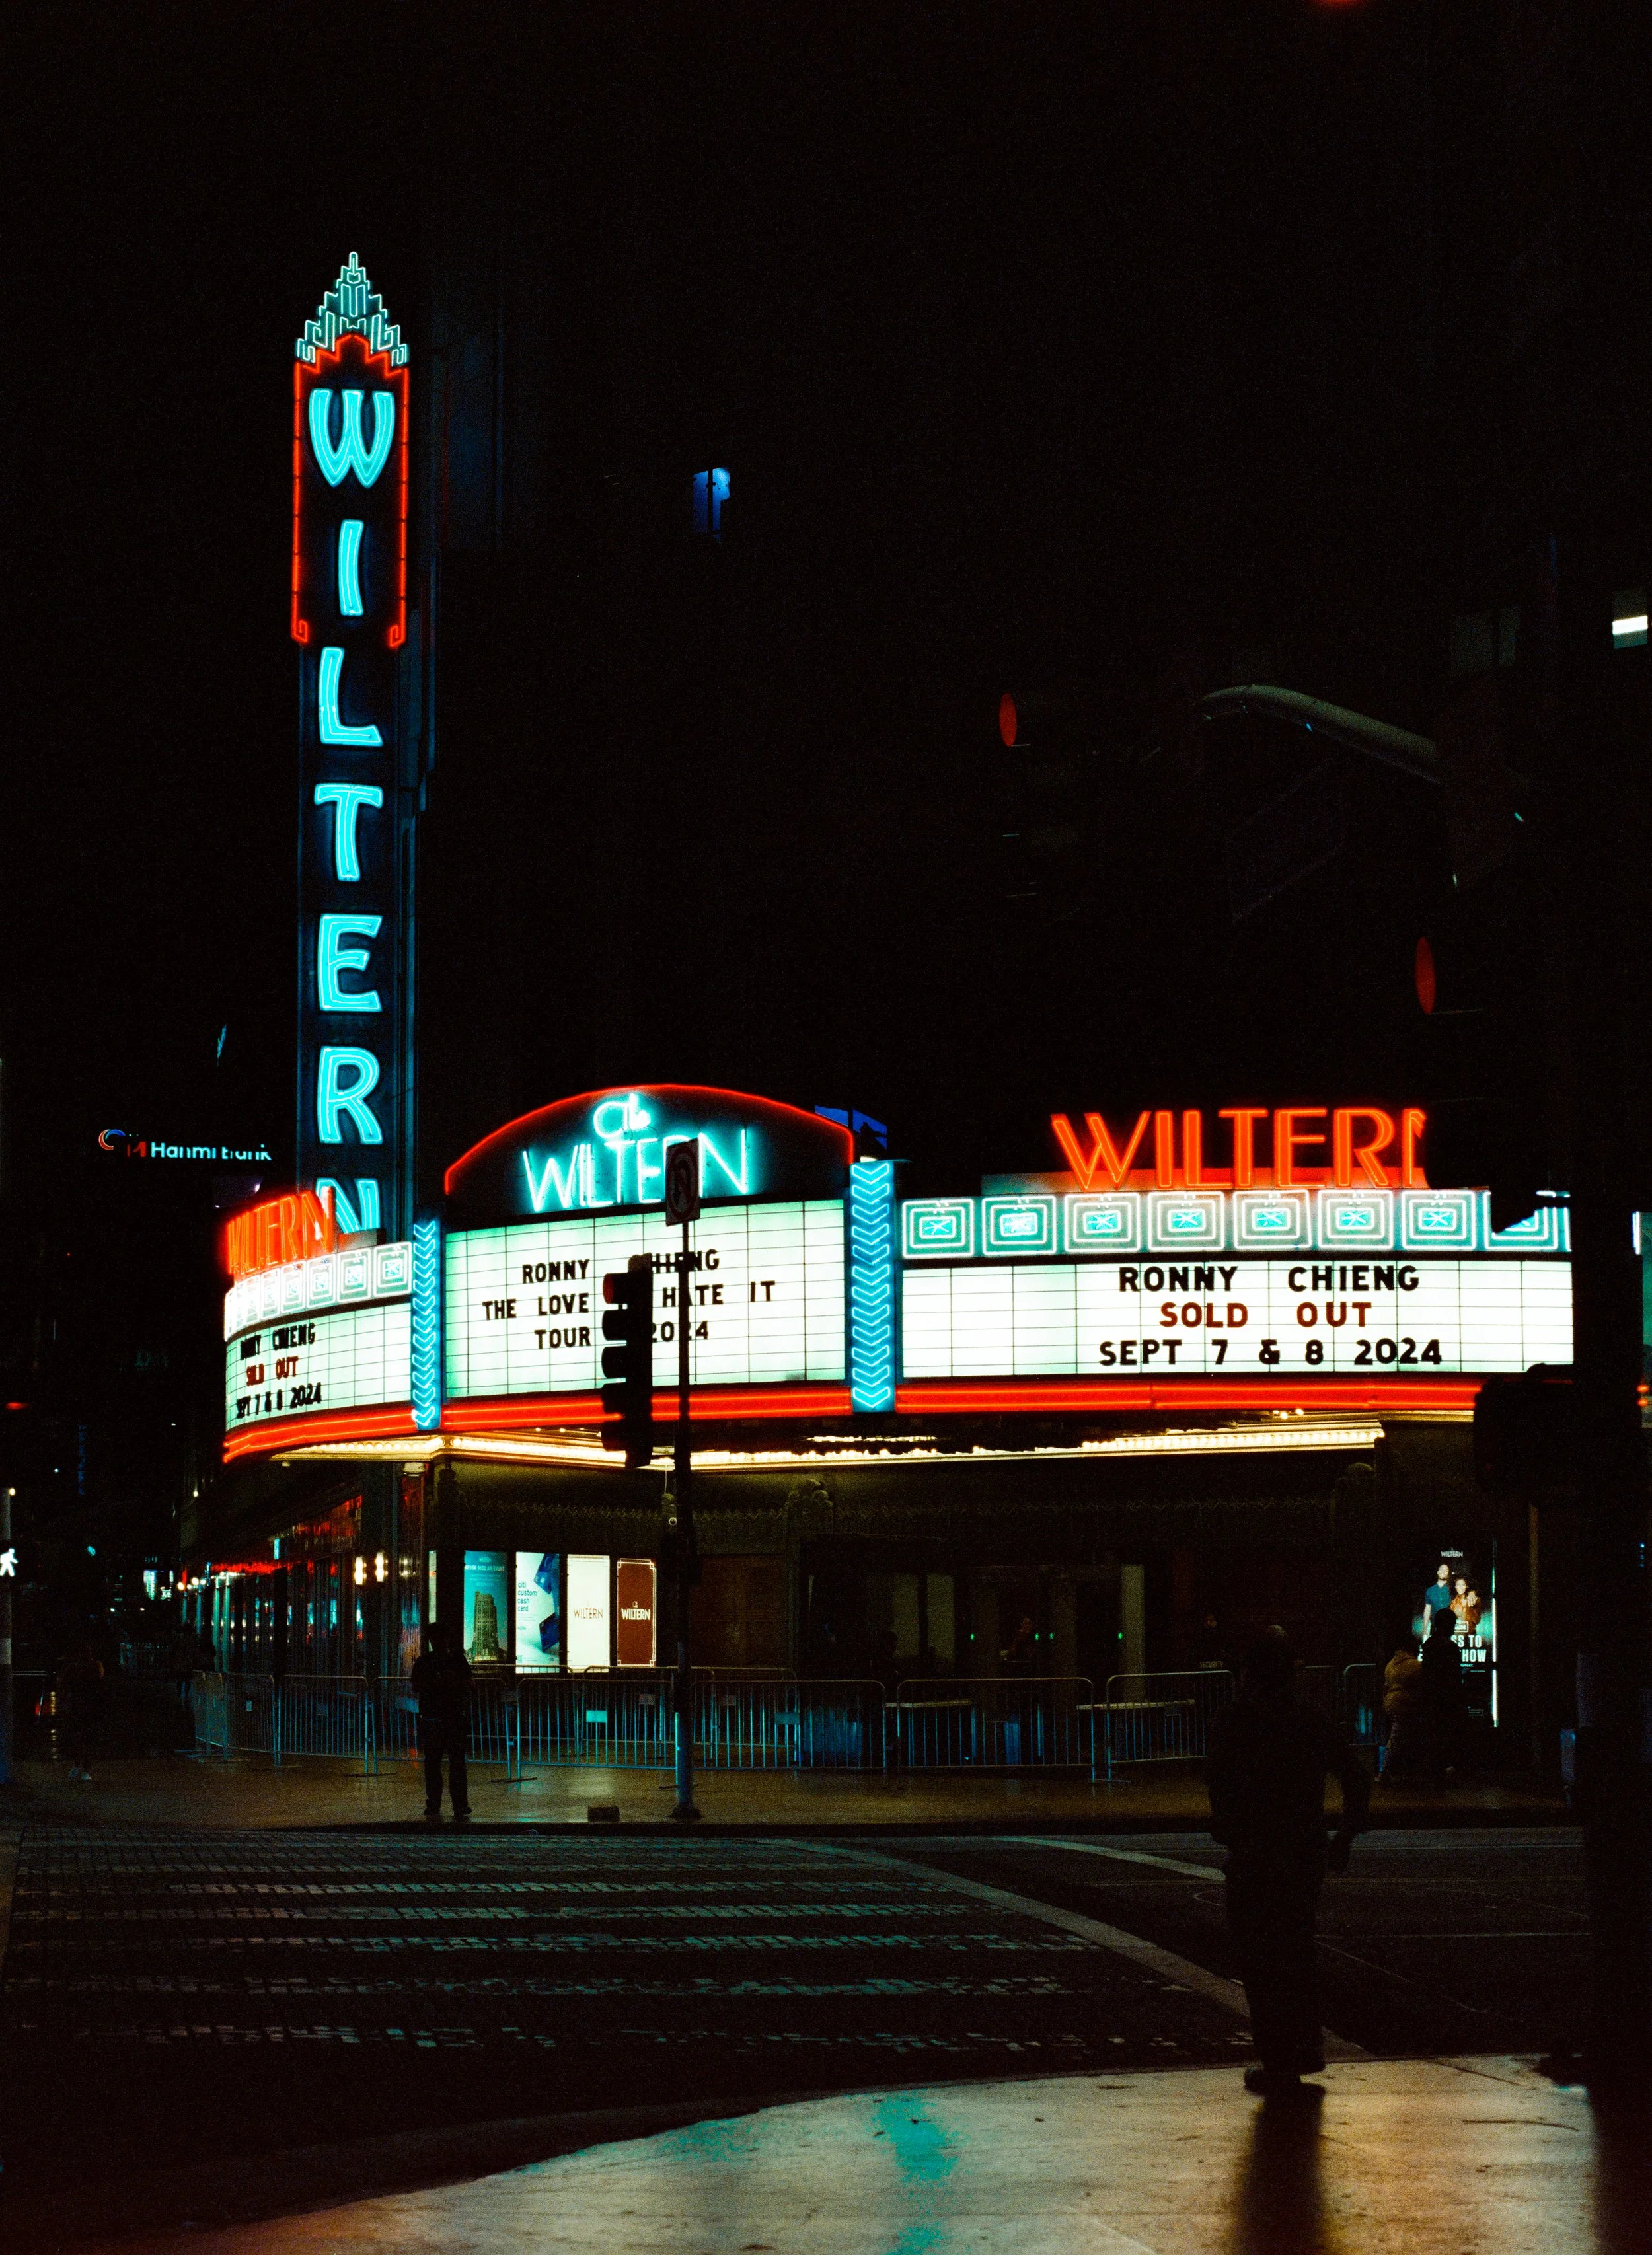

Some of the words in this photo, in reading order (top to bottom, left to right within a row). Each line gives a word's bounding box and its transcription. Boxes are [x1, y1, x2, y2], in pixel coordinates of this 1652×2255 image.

[309, 388, 395, 1234] WILTERN
[522, 1259, 590, 1284] RONNY
[1119, 1266, 1238, 1292] RONNY
[1288, 1265, 1419, 1292] CHIENG
[482, 1299, 517, 1320] THE
[538, 1293, 589, 1316] LOVE
[663, 1284, 724, 1308] HTE
[750, 1280, 776, 1302] IT
[1160, 1302, 1248, 1328] SOLD
[1297, 1302, 1372, 1327] OUT
[535, 1326, 591, 1349] TOUR
[1099, 1339, 1182, 1366] SEPT
[1211, 1339, 1228, 1365] 7
[1259, 1339, 1280, 1365] &
[1304, 1339, 1324, 1366] 8
[1354, 1337, 1442, 1366] 2024
[276, 1356, 299, 1380] OUT
[289, 1382, 321, 1409] 2024
[573, 1608, 603, 1619] WILTERN
[621, 1608, 650, 1620] WILTERN
[1468, 1635, 1482, 1648] TO
[1459, 1649, 1486, 1662] HOW
